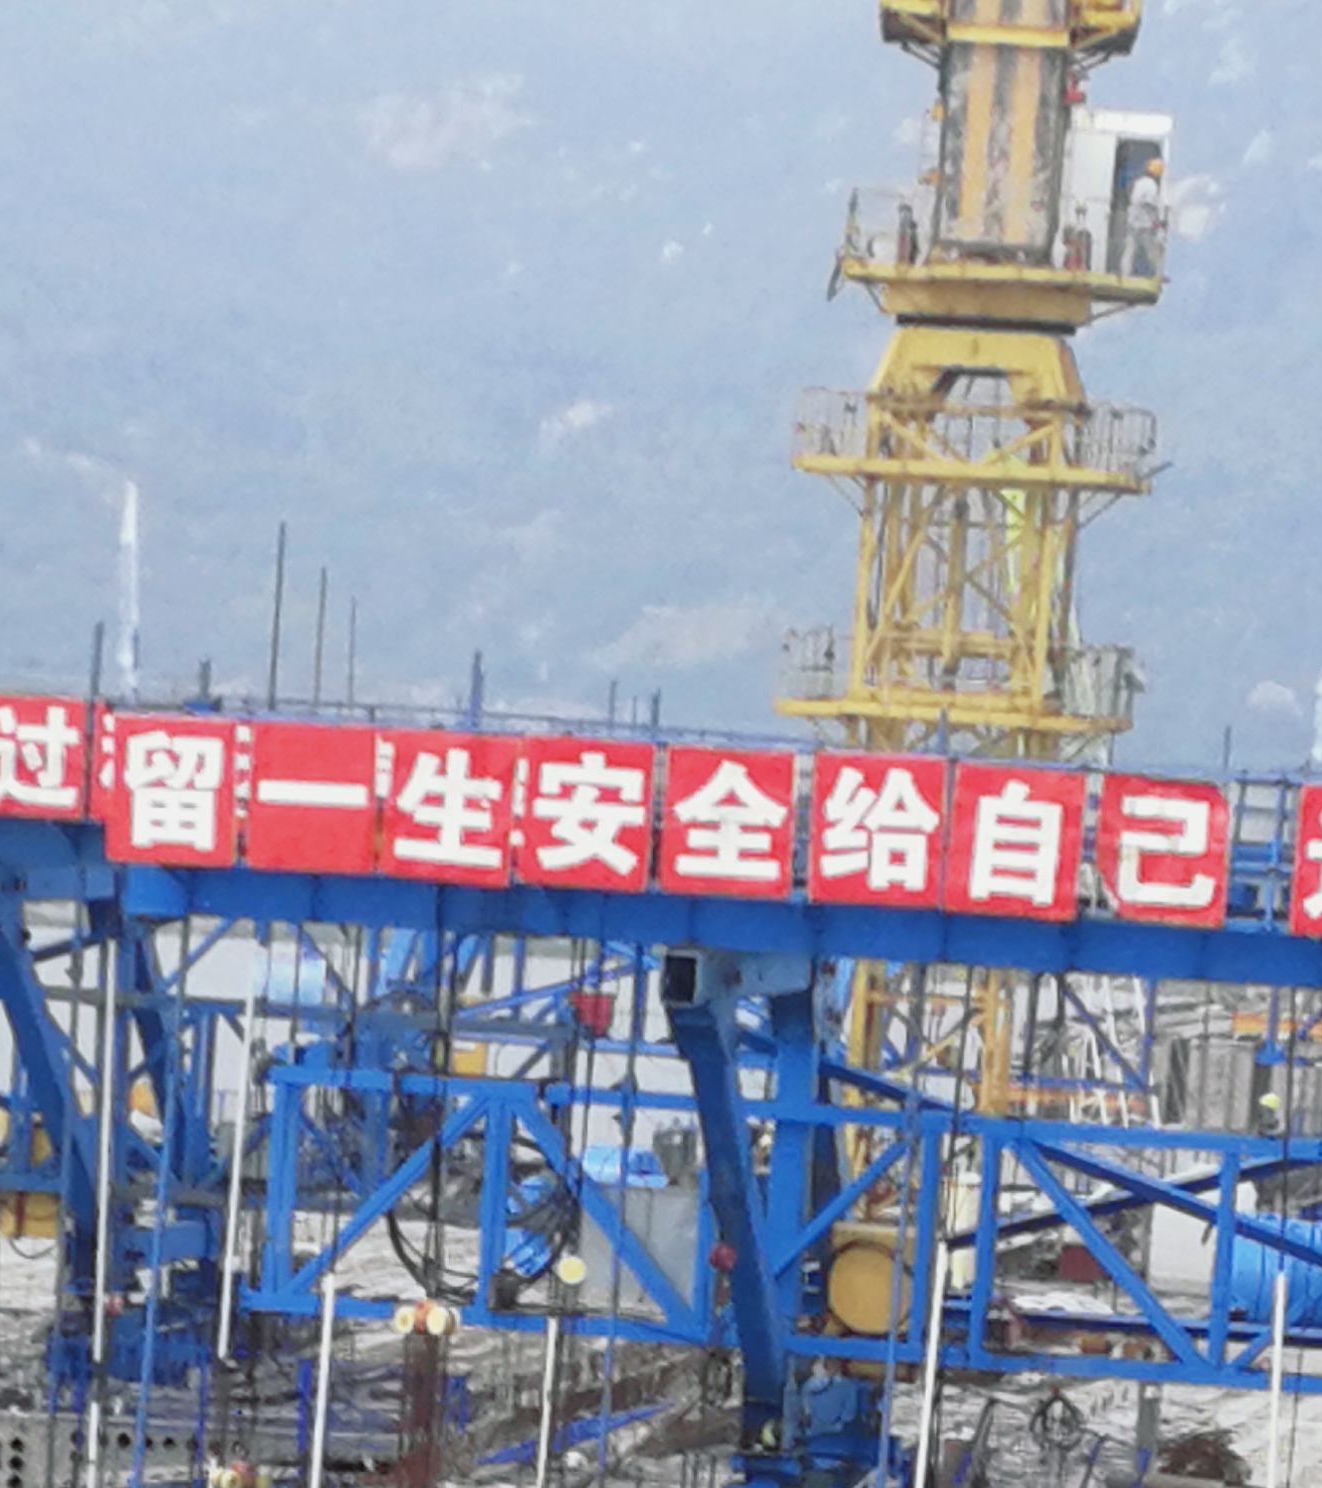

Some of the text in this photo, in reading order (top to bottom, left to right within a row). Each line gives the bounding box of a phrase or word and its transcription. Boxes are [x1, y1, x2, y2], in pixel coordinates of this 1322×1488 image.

[123, 730, 1215, 907] 留一生安全给自己
